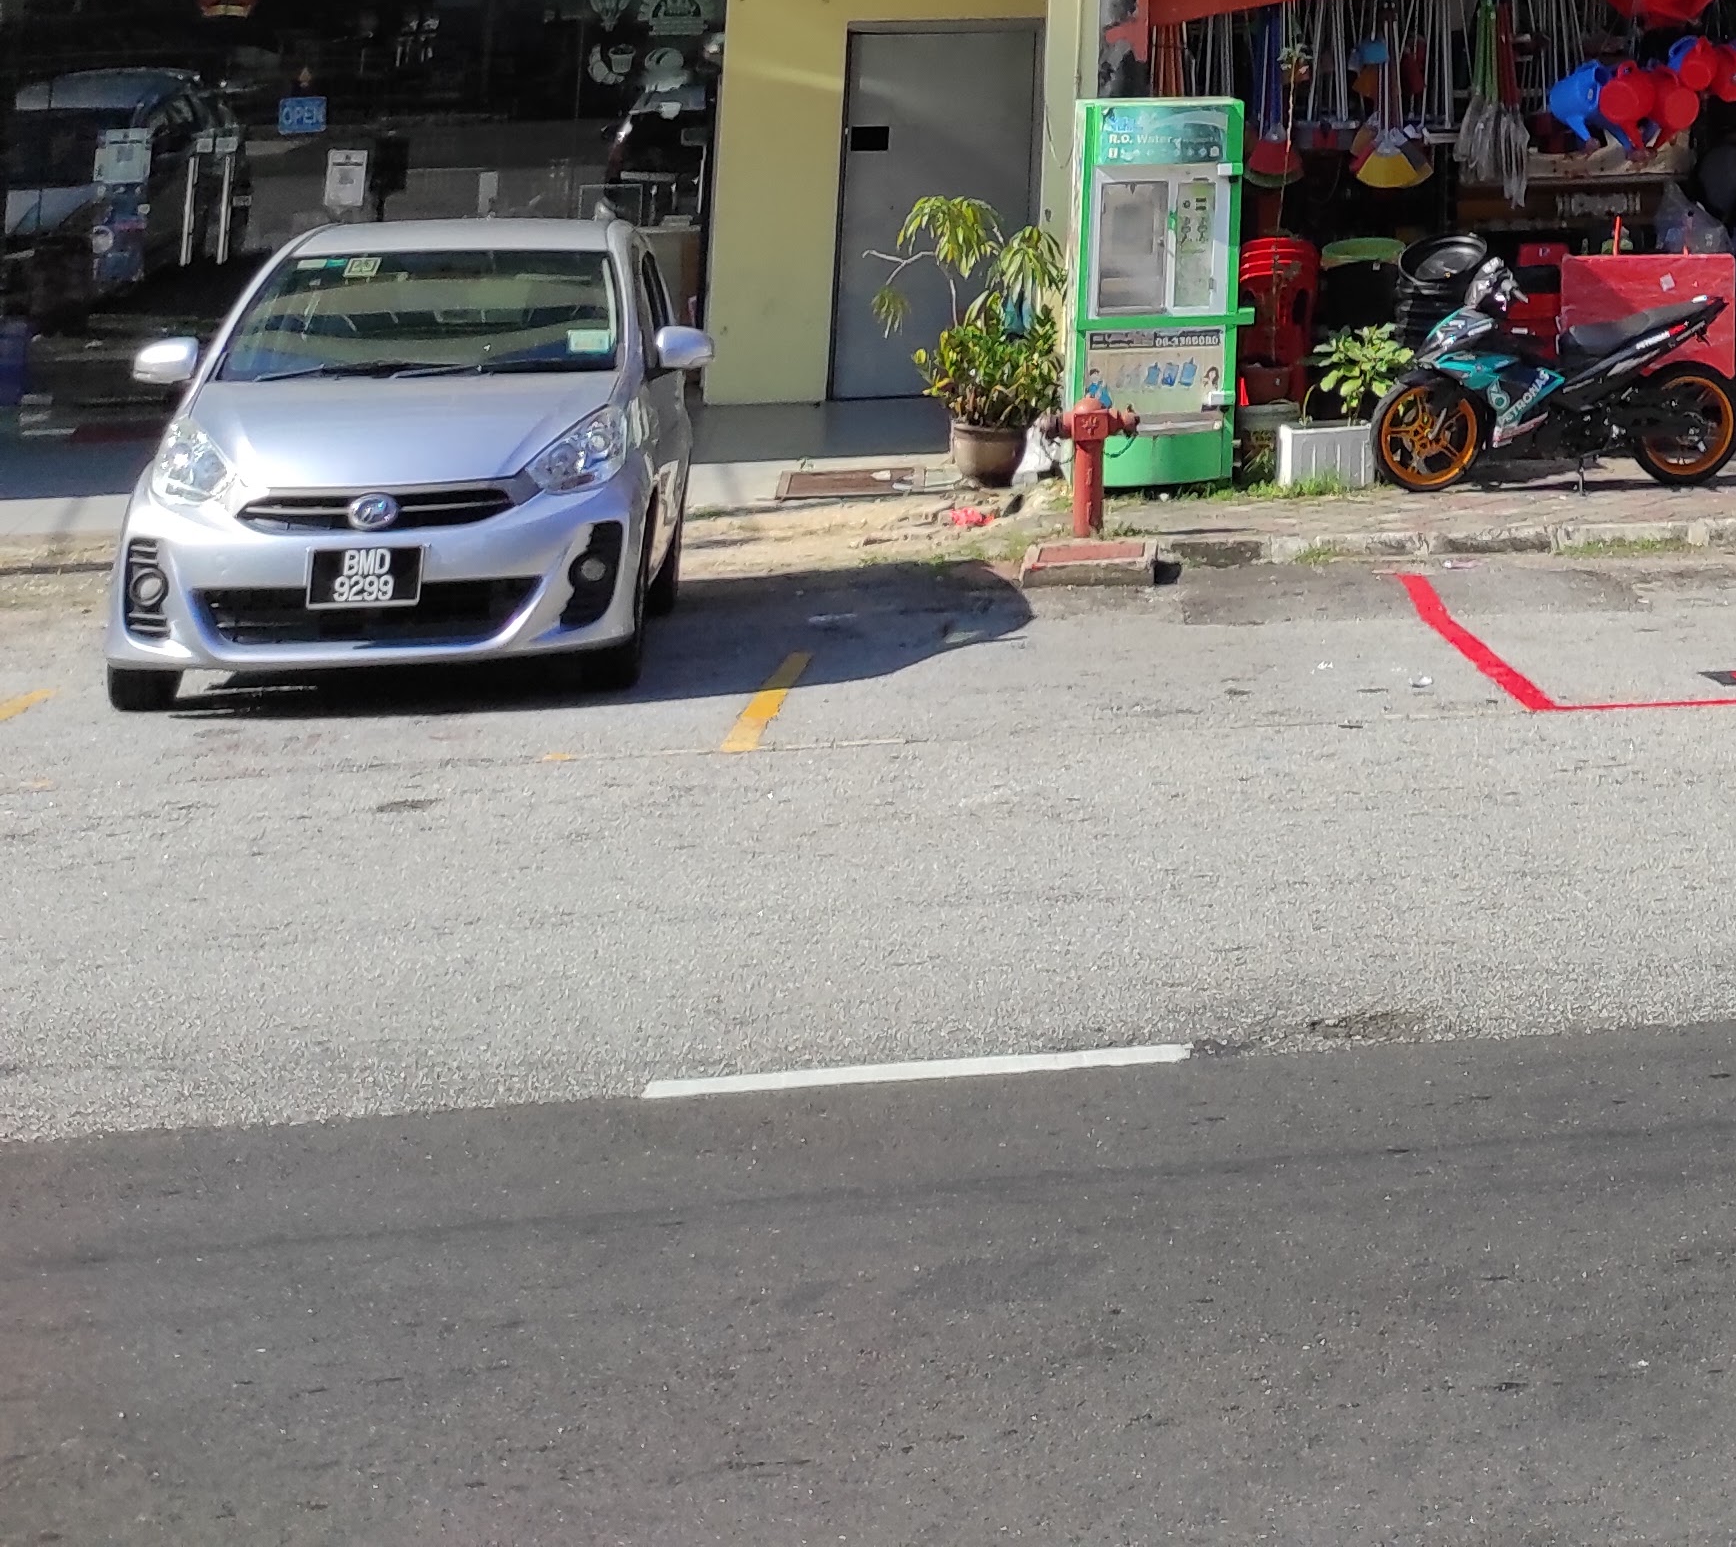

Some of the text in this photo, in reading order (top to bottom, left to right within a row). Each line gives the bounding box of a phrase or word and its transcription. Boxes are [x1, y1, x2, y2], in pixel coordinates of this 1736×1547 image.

[281, 105, 325, 125] OPEN
[1137, 134, 1173, 144] Water
[344, 548, 391, 576] BMD
[332, 574, 395, 602] 9299
